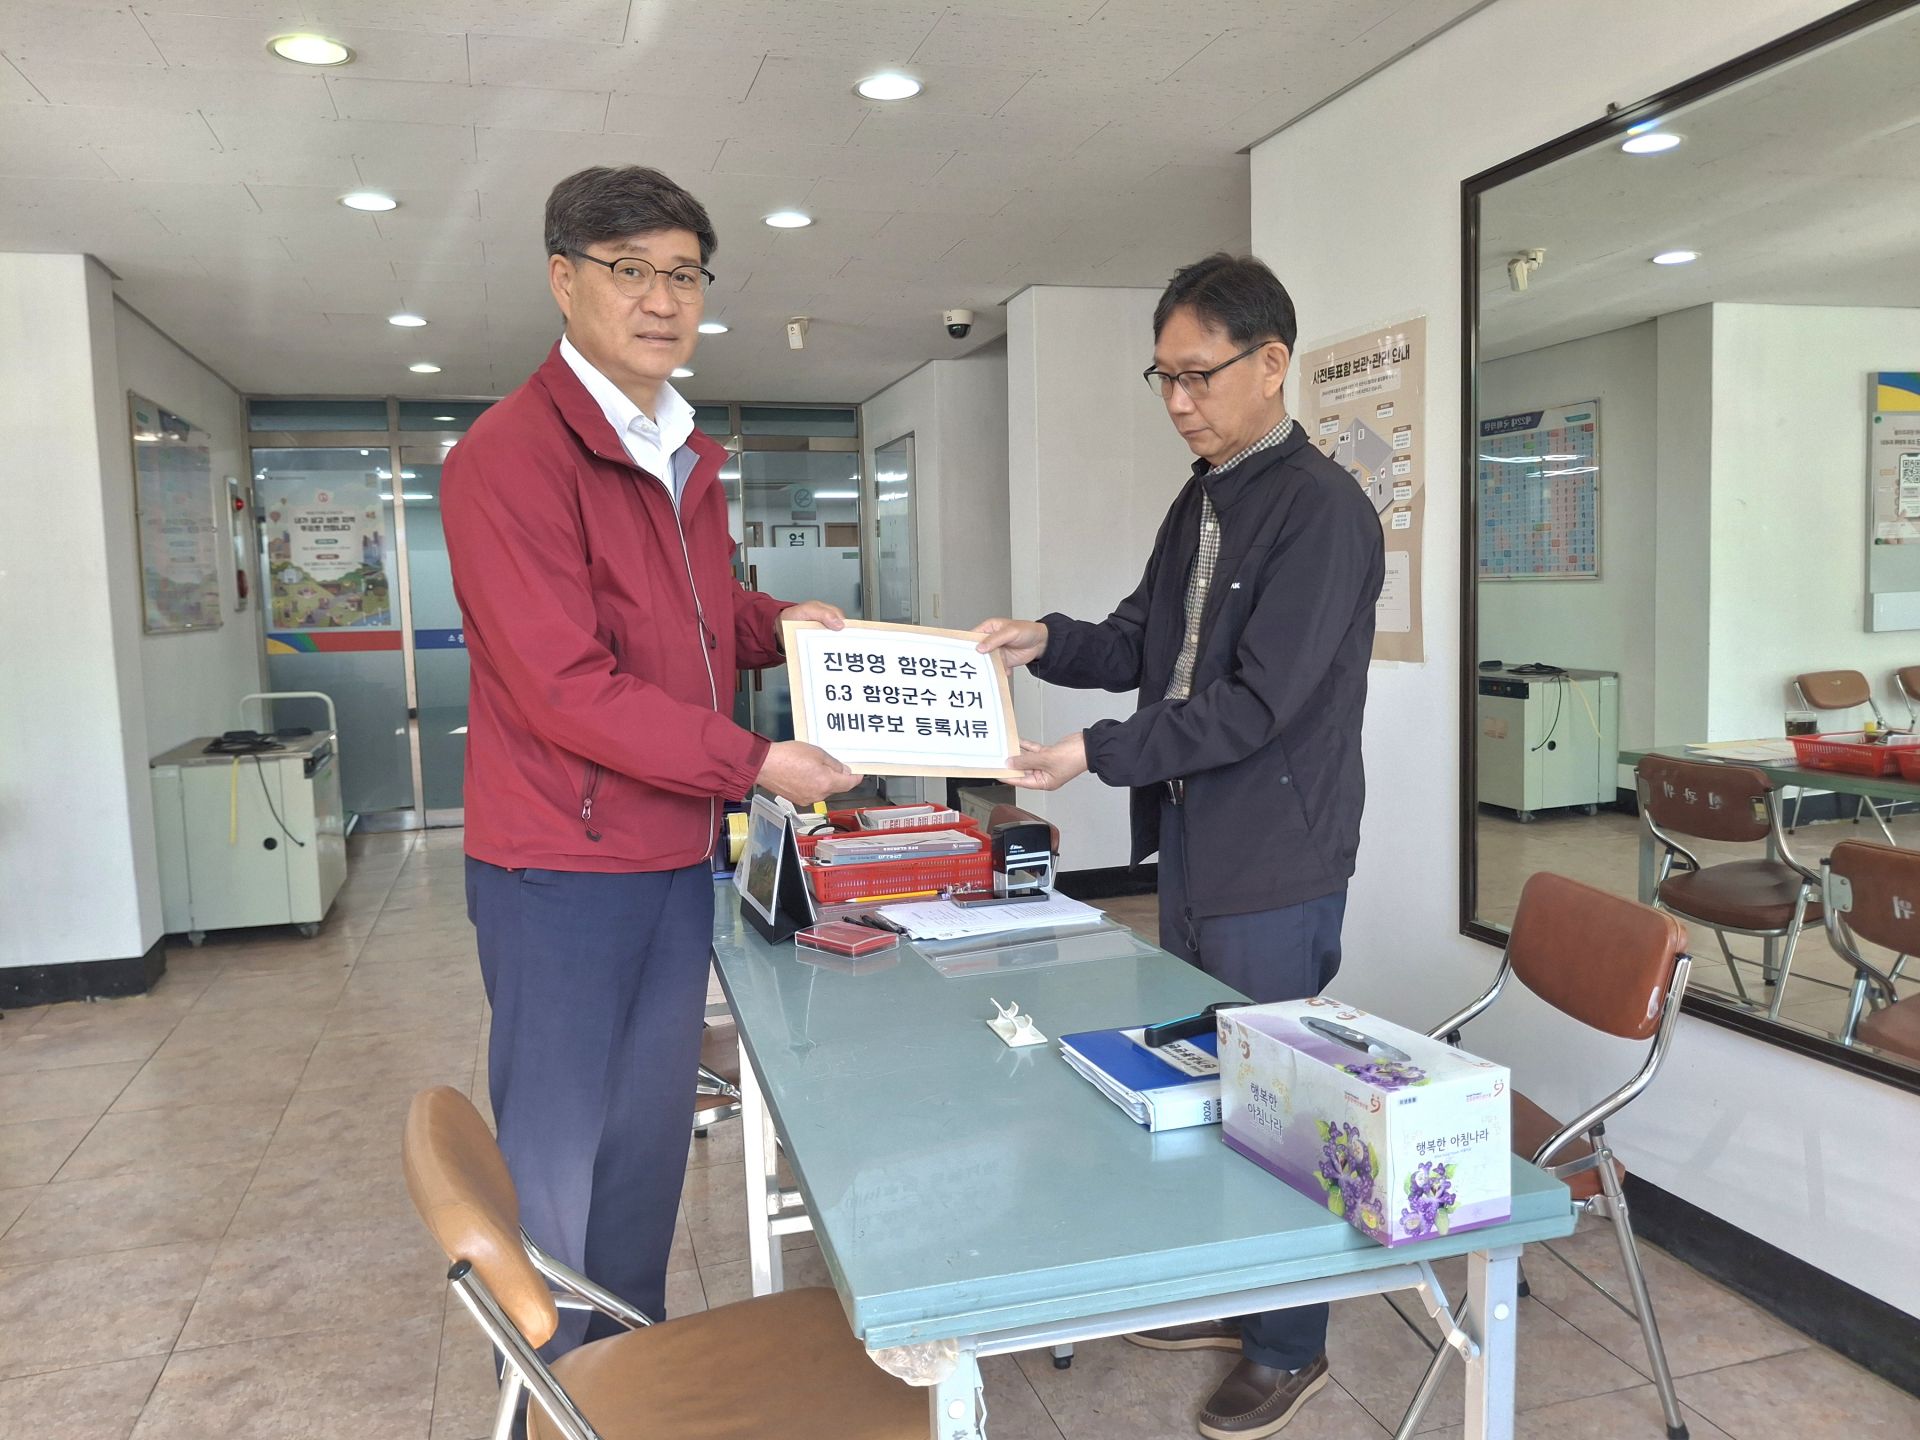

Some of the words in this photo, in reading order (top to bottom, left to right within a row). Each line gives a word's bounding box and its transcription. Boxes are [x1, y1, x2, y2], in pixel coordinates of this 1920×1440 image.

[1312, 361, 1351, 385] 사전투표함
[1391, 344, 1410, 364] 안내
[823, 652, 886, 674] 진병영
[898, 656, 978, 679] 함양군수
[825, 684, 853, 702] 6.3
[863, 685, 937, 706] 함양군수
[948, 690, 983, 709] 선거
[827, 712, 905, 733] 예비후보
[916, 717, 989, 739] 등록서류
[1203, 1099, 1212, 1122] 2026
[1250, 1082, 1277, 1113] 행복한
[1247, 1103, 1283, 1137] 아침나라
[1416, 1137, 1447, 1156] 행복한
[1450, 1128, 1489, 1148] 아침나라
